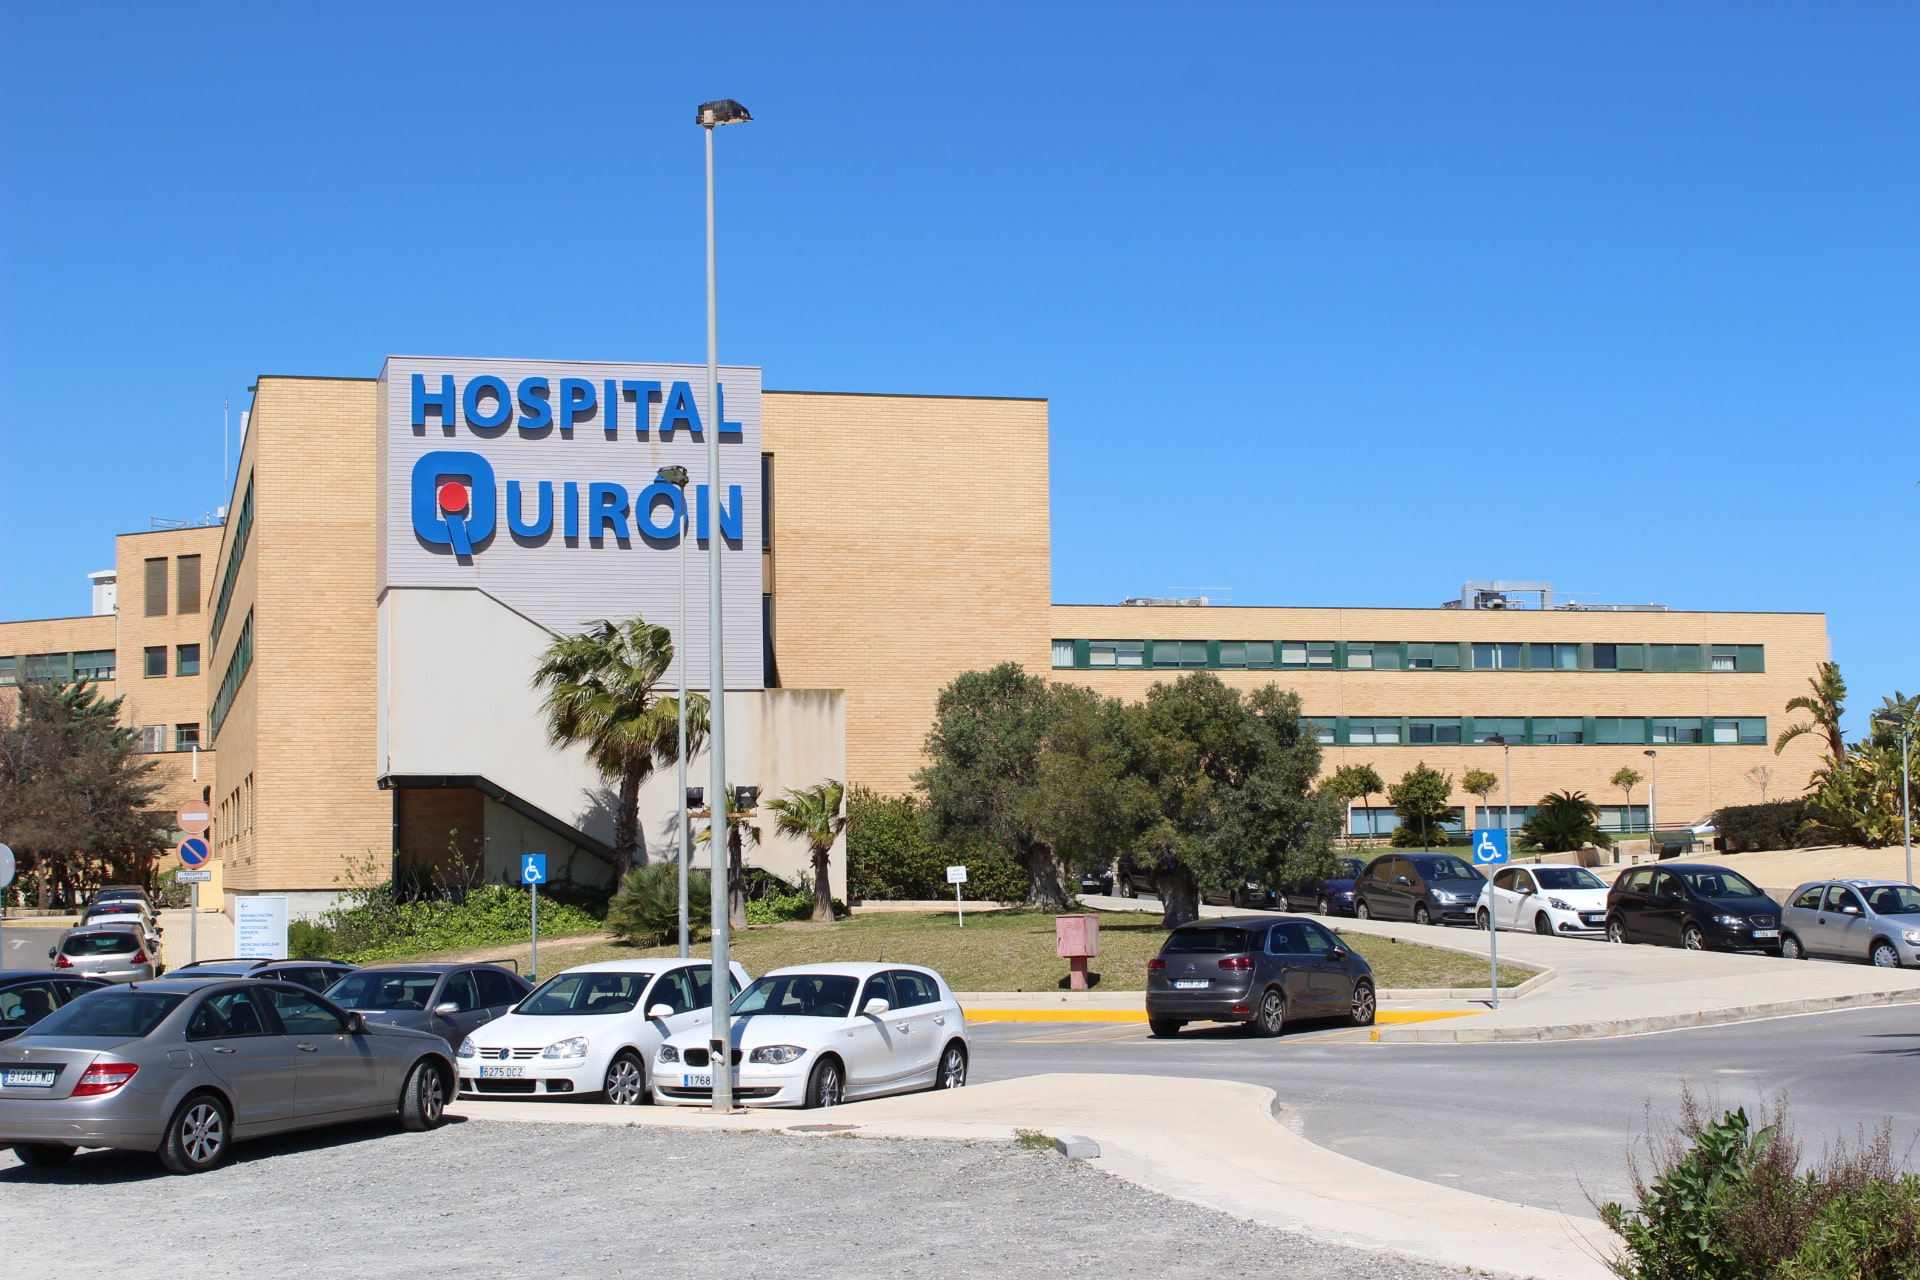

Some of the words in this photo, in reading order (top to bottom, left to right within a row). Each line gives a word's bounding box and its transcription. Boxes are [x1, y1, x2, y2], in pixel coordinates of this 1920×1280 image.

[411, 373, 743, 437] HOSPITAL
[411, 450, 743, 556] QUIRÓN
[10, 1070, 32, 1082] 9140
[484, 1067, 505, 1077] 6275
[506, 1067, 523, 1077] DCZ
[690, 1075, 711, 1086] 1768
